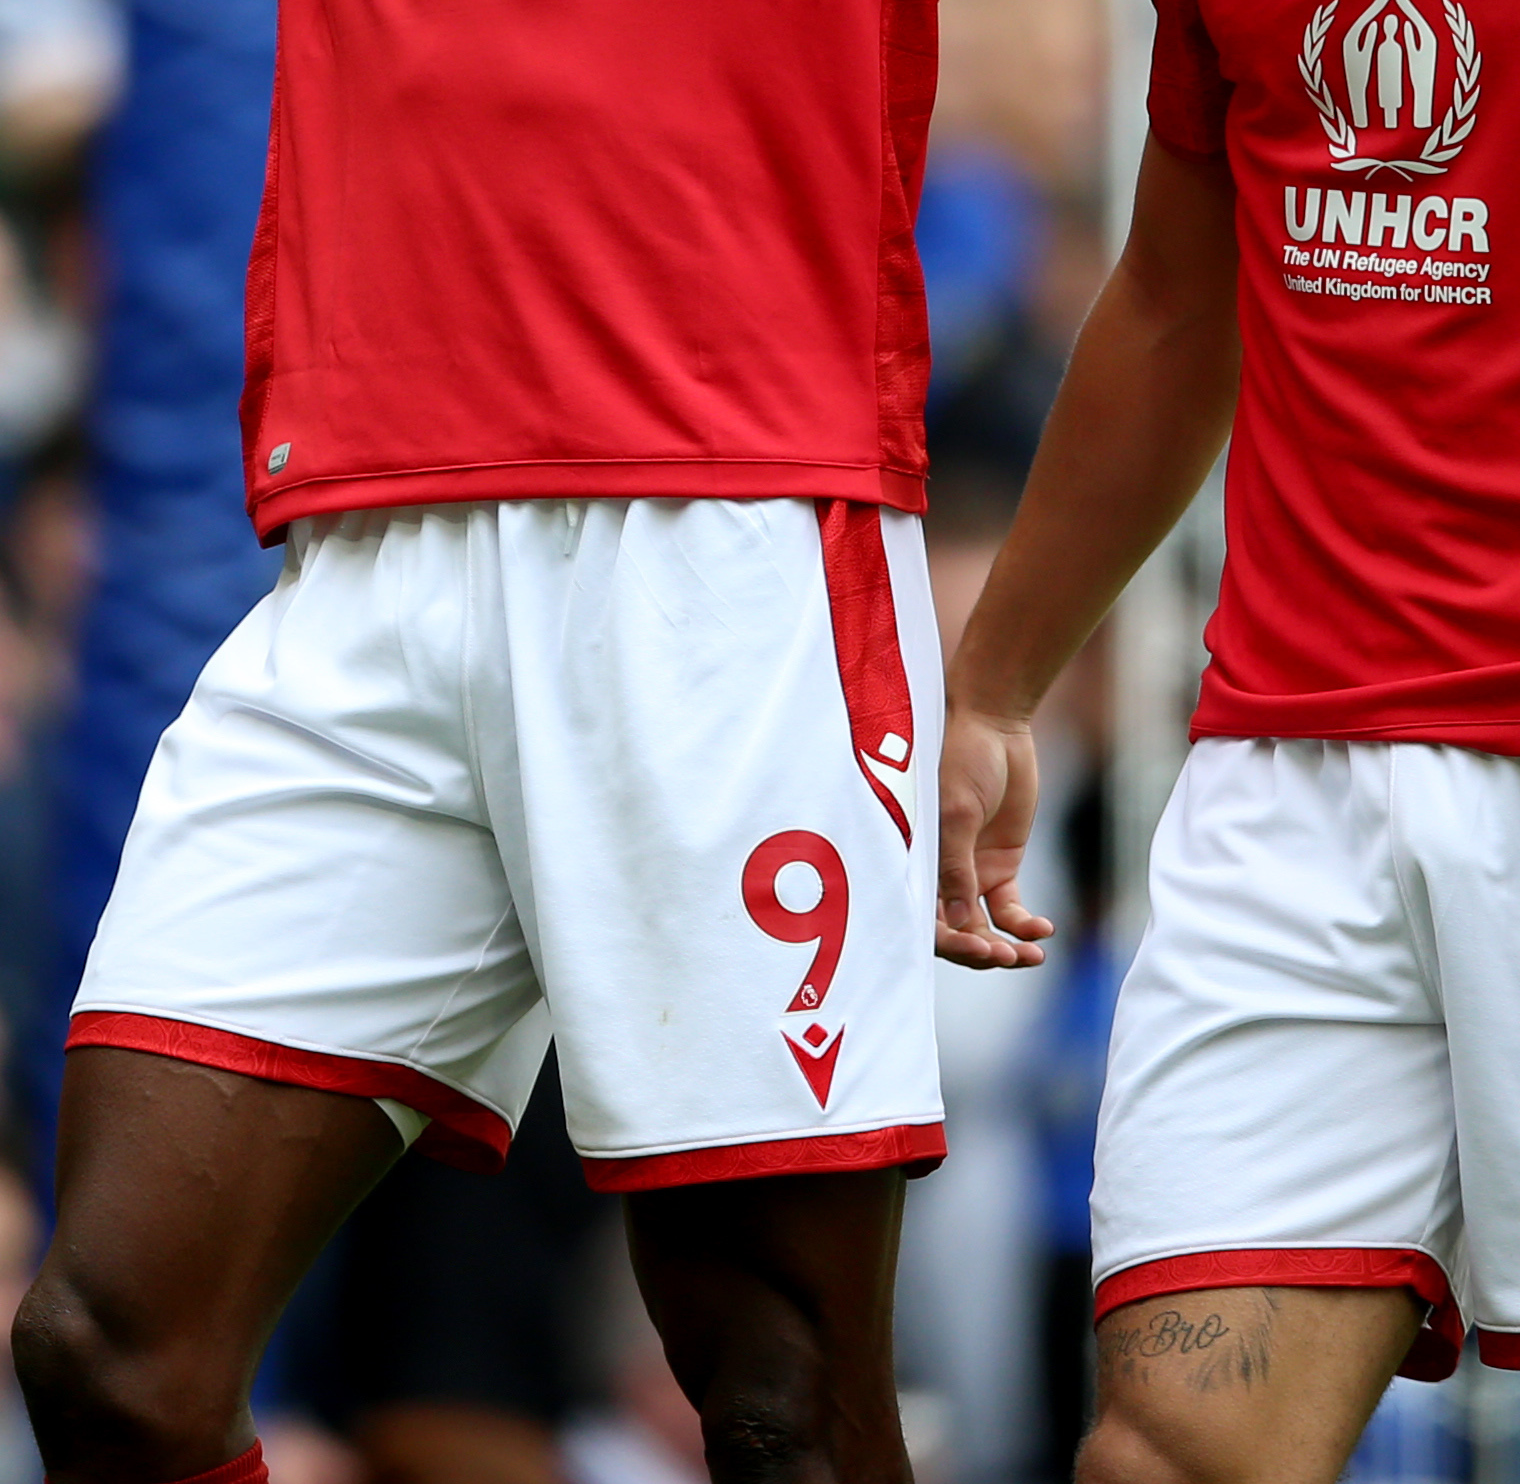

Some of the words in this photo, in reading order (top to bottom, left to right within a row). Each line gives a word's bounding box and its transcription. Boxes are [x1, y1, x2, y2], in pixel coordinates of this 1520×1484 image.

[1284, 185, 1490, 253] UNHCR
[1283, 245, 1310, 266] The
[1312, 248, 1341, 269] UN
[1343, 250, 1418, 278] Refugee
[1419, 256, 1490, 282] Agency
[1283, 273, 1322, 294] United
[1325, 278, 1397, 301] Kingdom
[1399, 283, 1422, 301] for
[1424, 284, 1492, 305] UNHCR
[740, 828, 850, 1016] 9
[1139, 1310, 1229, 1357] Bro
